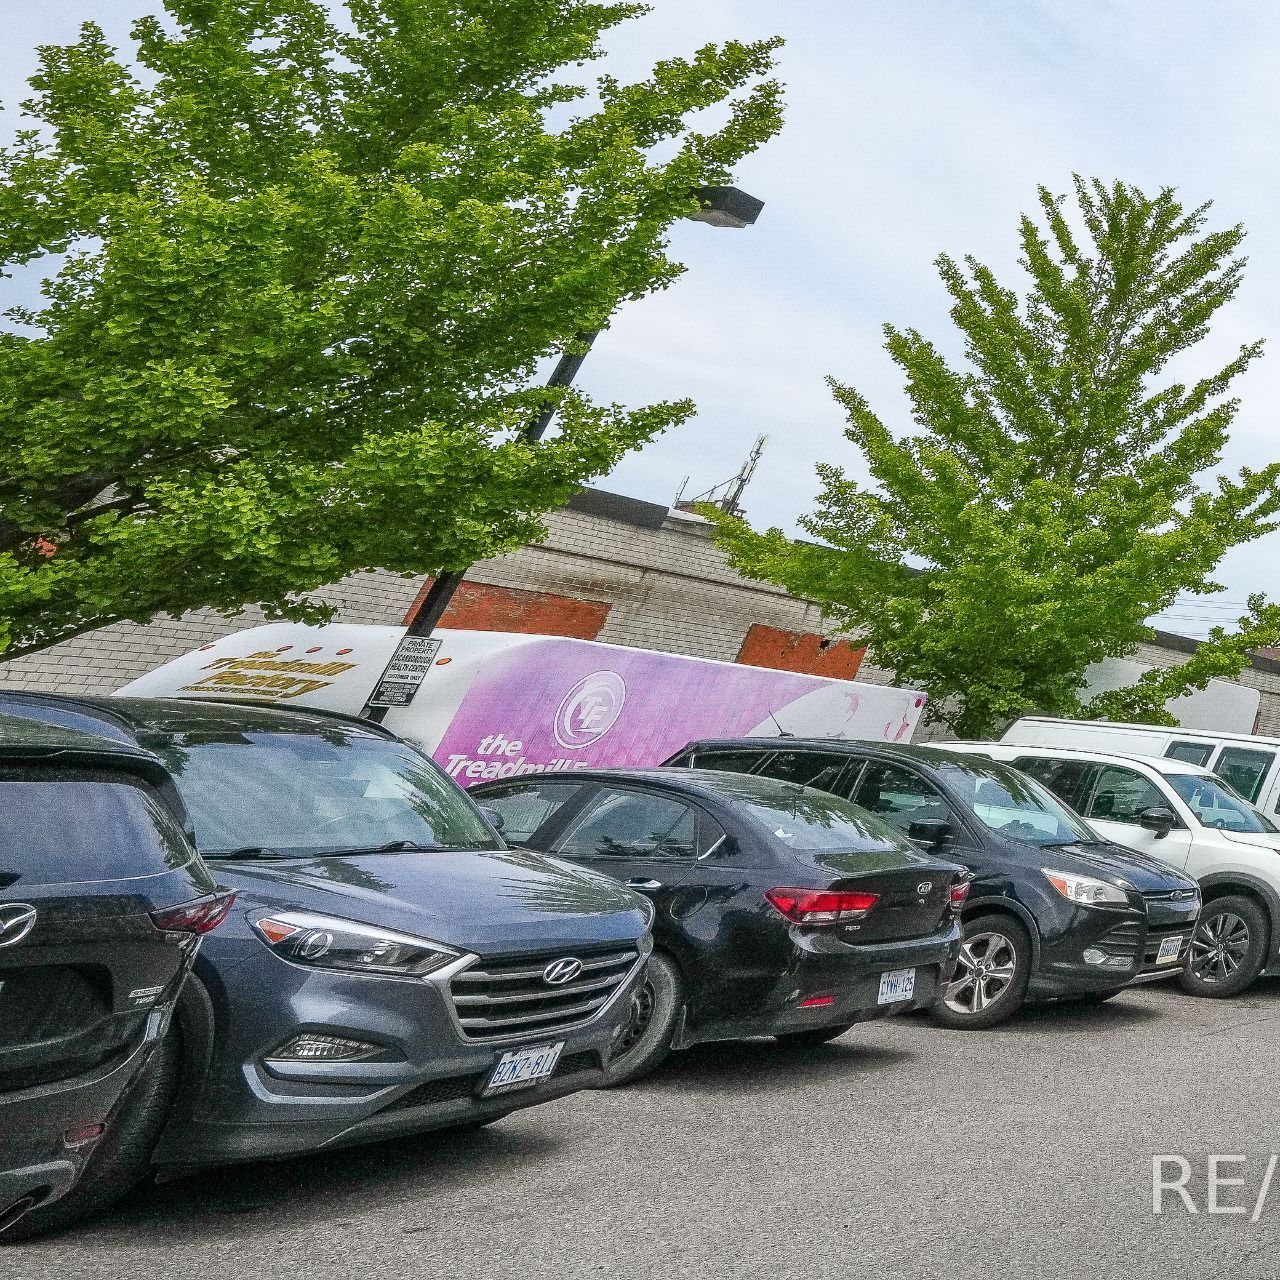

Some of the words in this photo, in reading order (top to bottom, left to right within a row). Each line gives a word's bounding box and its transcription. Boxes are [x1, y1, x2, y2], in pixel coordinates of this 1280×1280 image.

[408, 641, 434, 649] PRIVATE
[401, 646, 435, 655] PROPERTY
[477, 734, 522, 756] the
